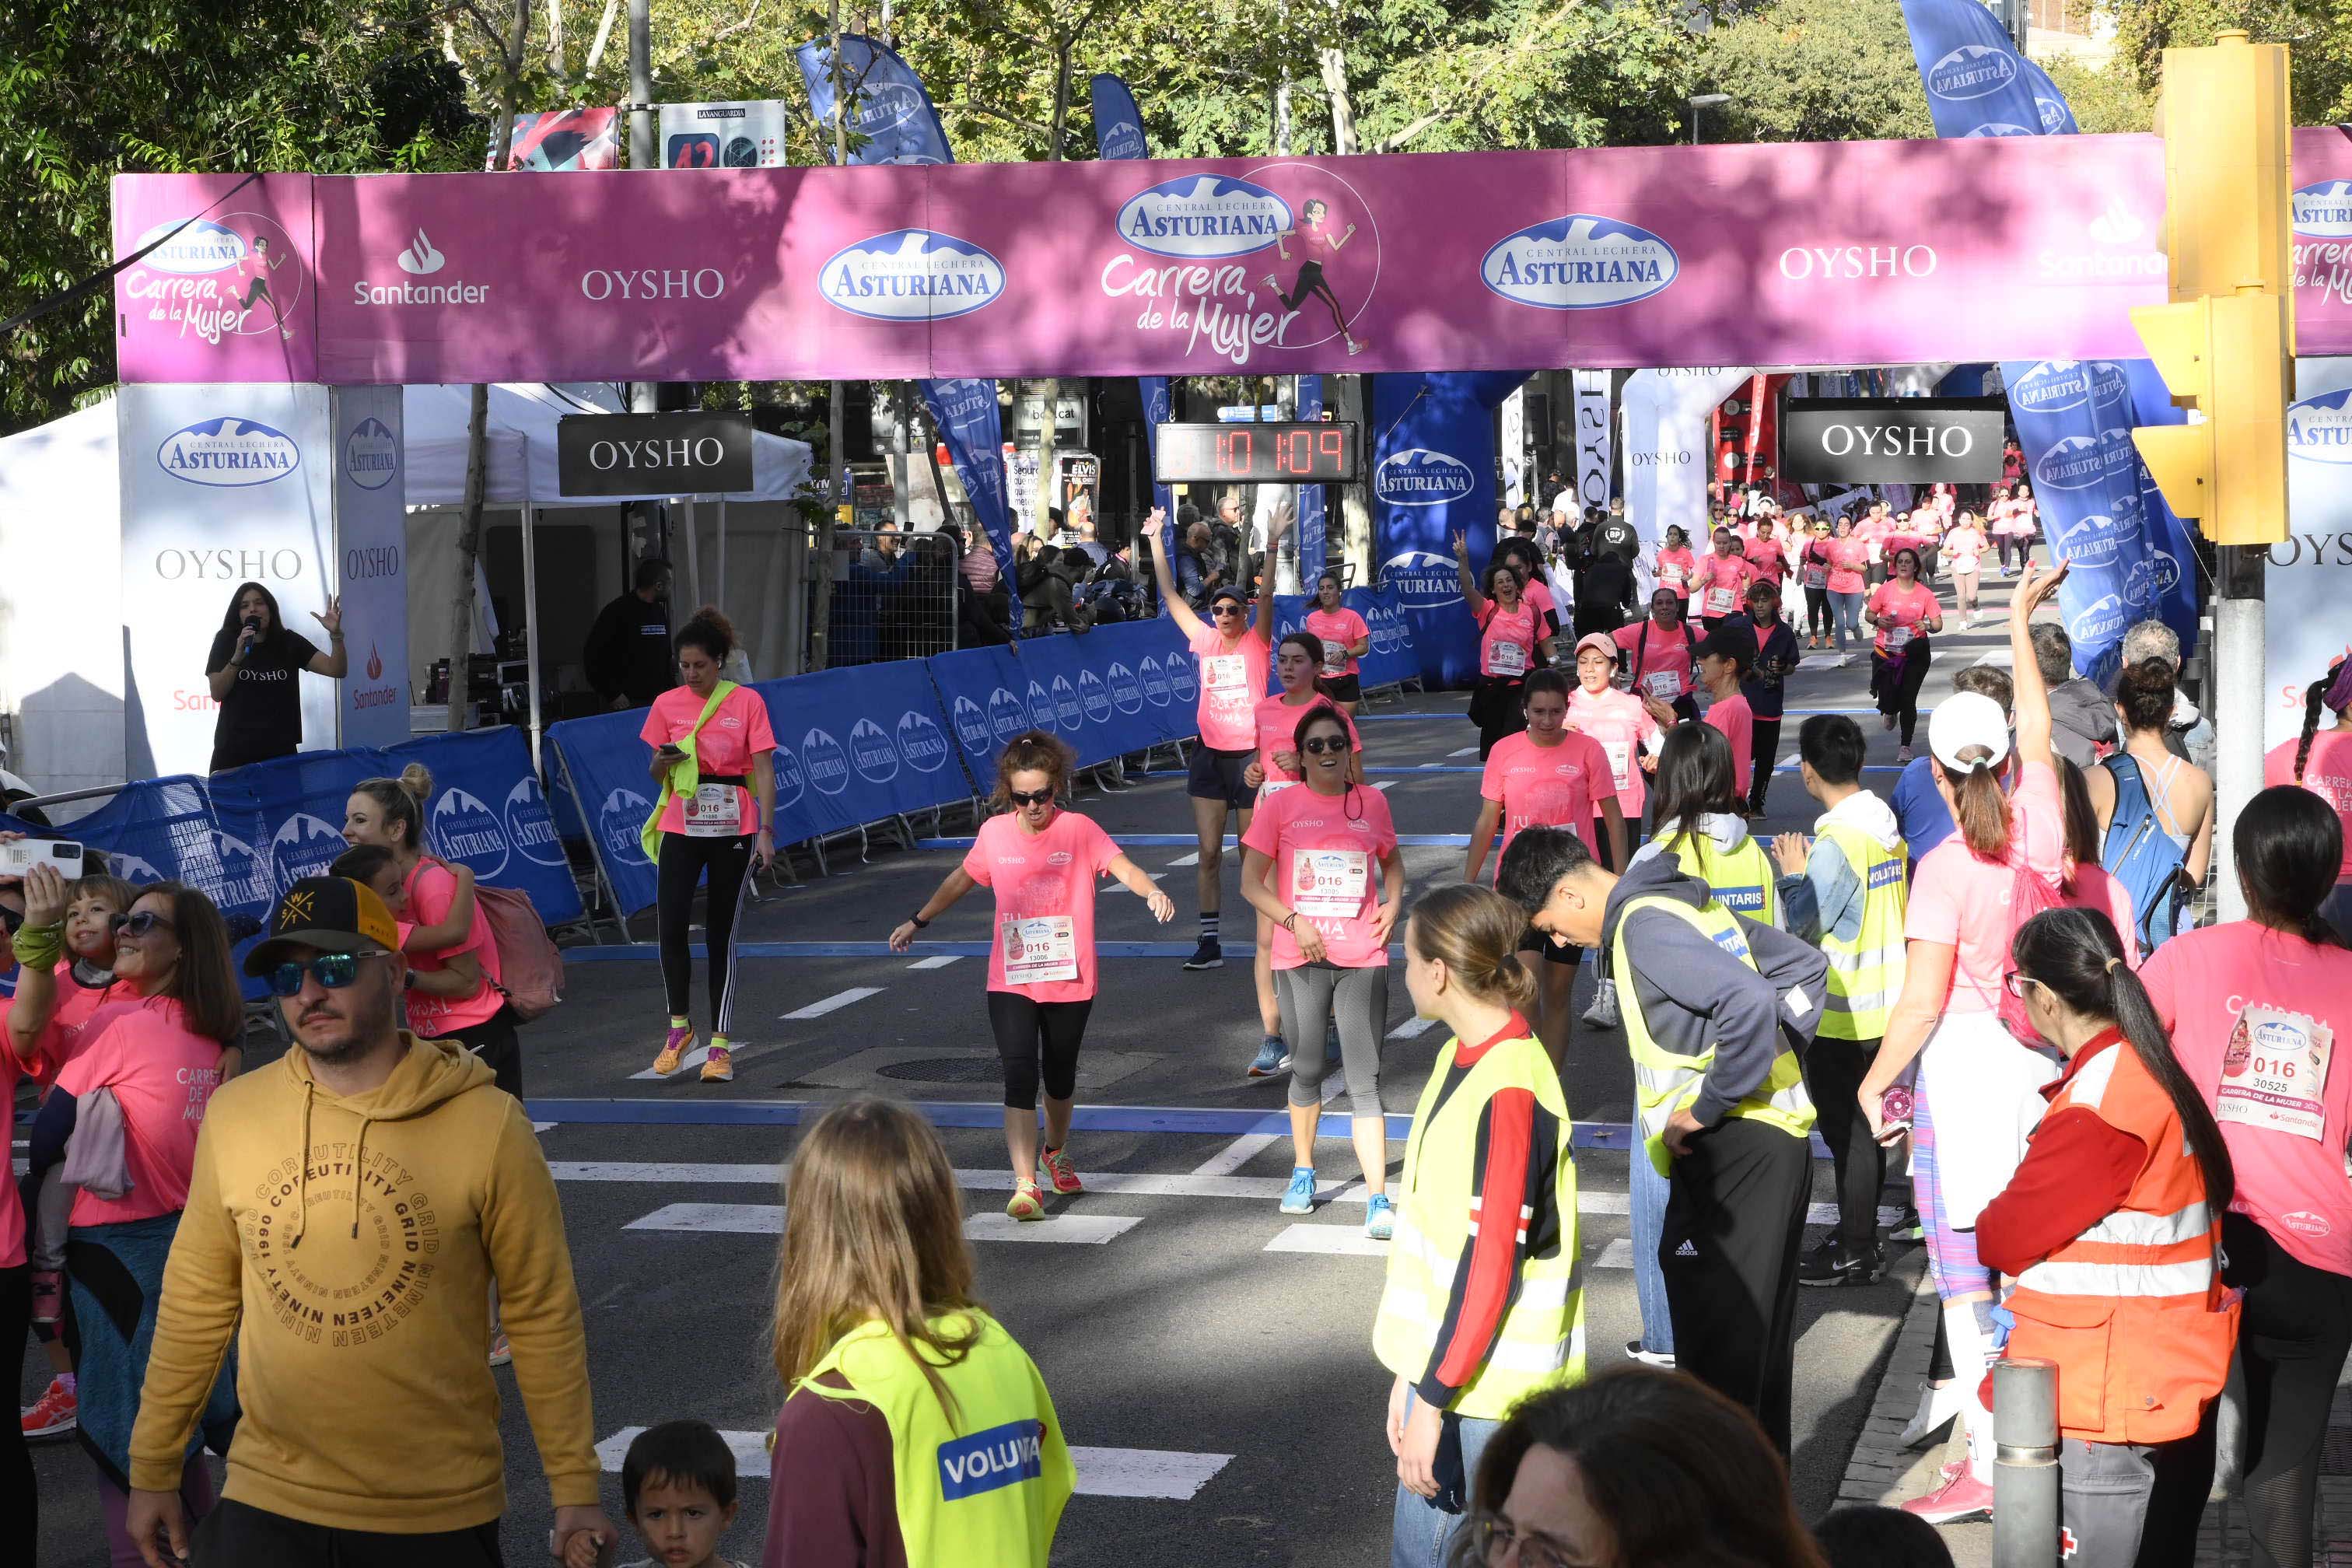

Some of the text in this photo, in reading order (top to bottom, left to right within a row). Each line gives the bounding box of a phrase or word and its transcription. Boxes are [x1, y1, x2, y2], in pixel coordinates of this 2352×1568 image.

[1157, 201, 1274, 212] CENTRAL LECHERA
[1129, 205, 1279, 237] ASTURIANA
[927, 260, 985, 269] LECHERA
[1526, 246, 1657, 257] CENTRAL LECHERA
[1779, 244, 1937, 280] OYSHO
[2039, 248, 2167, 276] Santand
[833, 264, 991, 297] ASTURIANA
[1101, 254, 1247, 297] Carrera
[1496, 251, 1663, 287] ASTURIANA
[125, 270, 218, 299] Carrera
[354, 281, 489, 305] Santander
[582, 268, 724, 300] OYSHO
[149, 296, 253, 345] de la Mujer
[1137, 292, 1300, 365] de la Mujer
[2308, 415, 2352, 424] CENTRA
[589, 436, 725, 471] OYSHO
[1822, 425, 1972, 457] OYSHO
[169, 443, 290, 469] ASTURIANA
[349, 446, 394, 472] ASTURIANA
[1072, 464, 1096, 474] ELVIS
[1633, 451, 1691, 466] OYSHO
[1379, 471, 1467, 492] ASTURIANA
[156, 548, 302, 579] OYSHO
[347, 545, 398, 580] OYSHO
[239, 669, 288, 681] OYSHO
[353, 684, 397, 710] Santander
[856, 746, 897, 768] ASTURIANA
[2318, 787, 2333, 799] DE
[1293, 820, 1324, 828] OYSHO
[443, 826, 506, 860] ASTURIANA
[1318, 877, 1342, 885] 016
[1027, 942, 1050, 953] 016
[2257, 1030, 2302, 1046] ASTURIANA
[2254, 1057, 2295, 1078] 016
[189, 1088, 202, 1102] DE
[2221, 1088, 2252, 1097] CARRERA
[2277, 1098, 2302, 1108] MUJER
[2253, 1078, 2287, 1093] 30525
[259, 1215, 272, 1258] 1990
[395, 1202, 419, 1252] GRID
[410, 1192, 439, 1254] GRID
[267, 1268, 324, 1323] NINETY
[333, 1264, 435, 1347] NINETEEN
[334, 1260, 416, 1326] NINETEEN
[944, 1436, 1041, 1484] VOLUNTA
